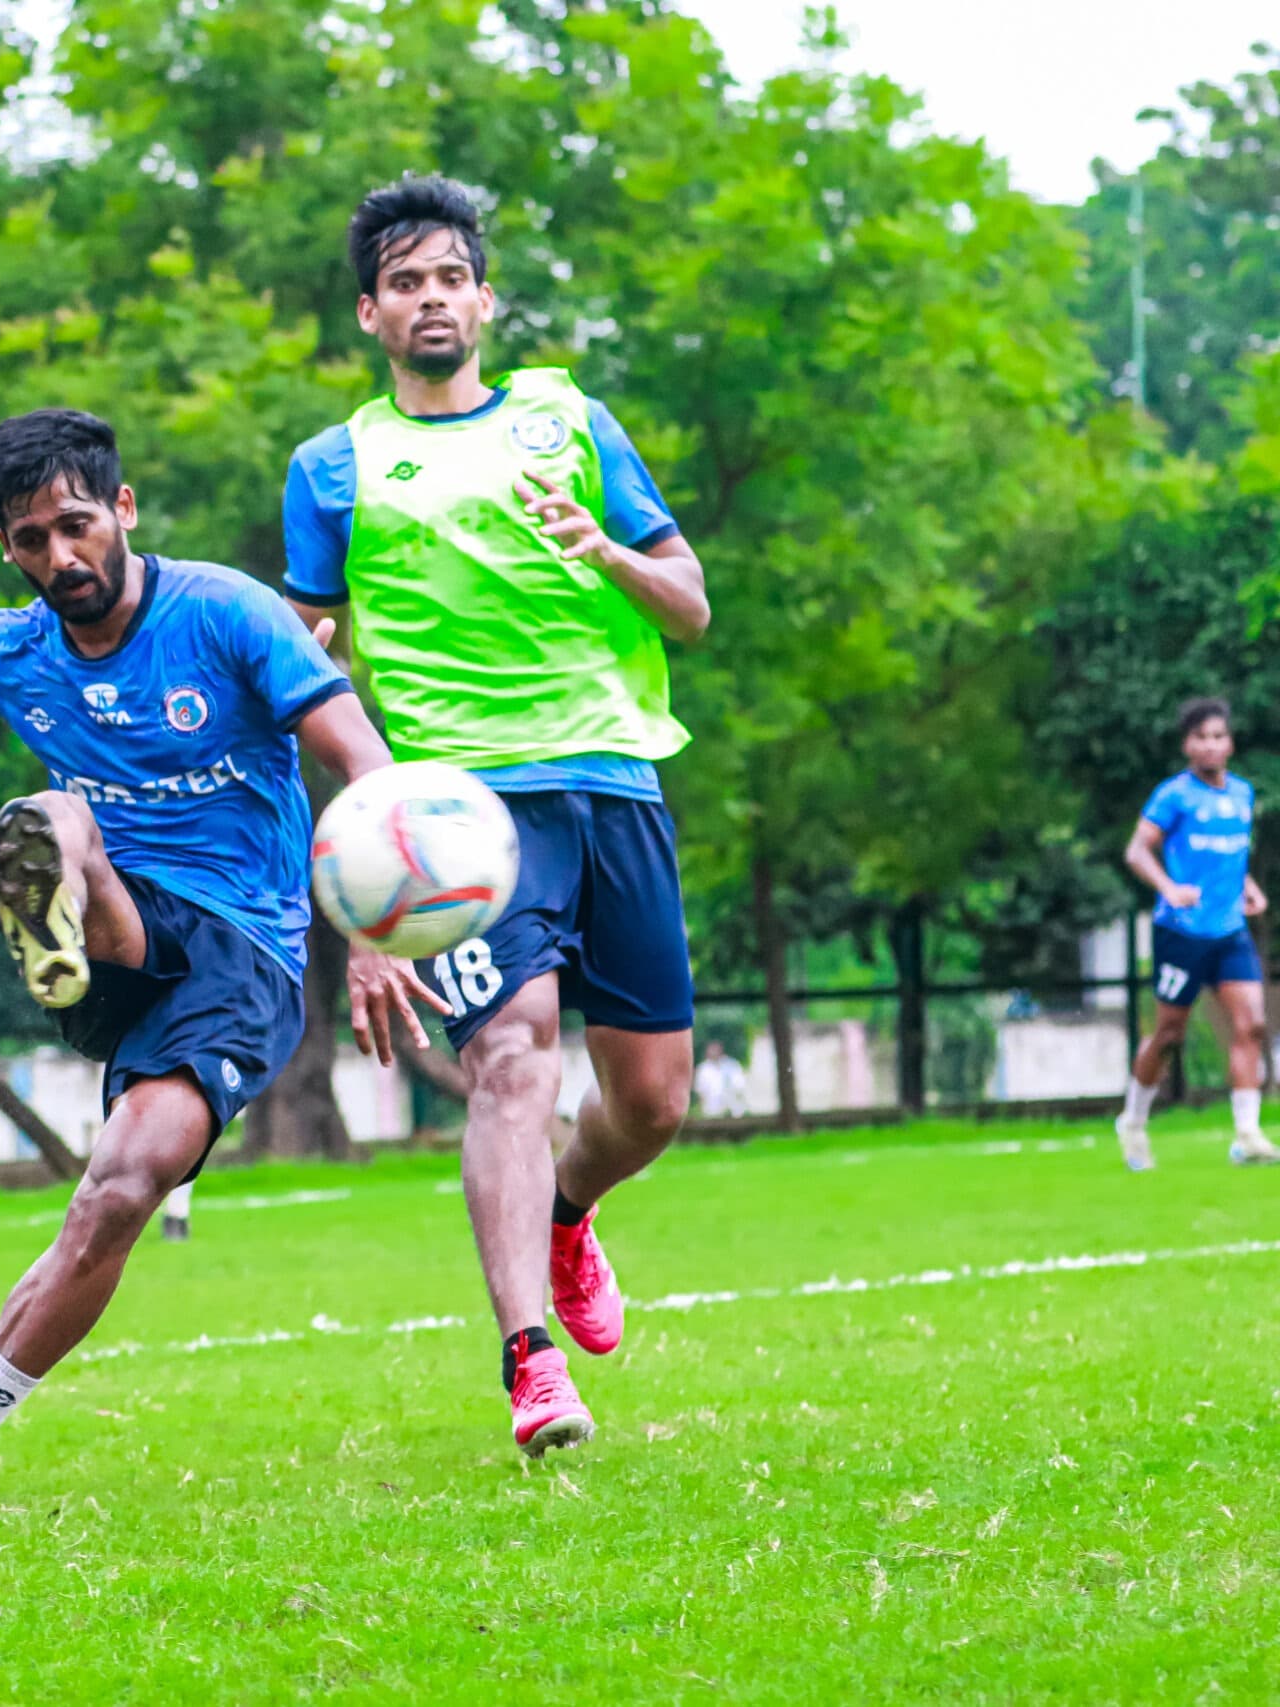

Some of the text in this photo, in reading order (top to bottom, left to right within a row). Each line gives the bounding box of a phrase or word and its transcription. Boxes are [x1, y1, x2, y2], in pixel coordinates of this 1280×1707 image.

[87, 709, 132, 726] TATA
[140, 753, 247, 804] STEEL
[434, 937, 504, 1019] 18
[1157, 962, 1189, 1000] 17
